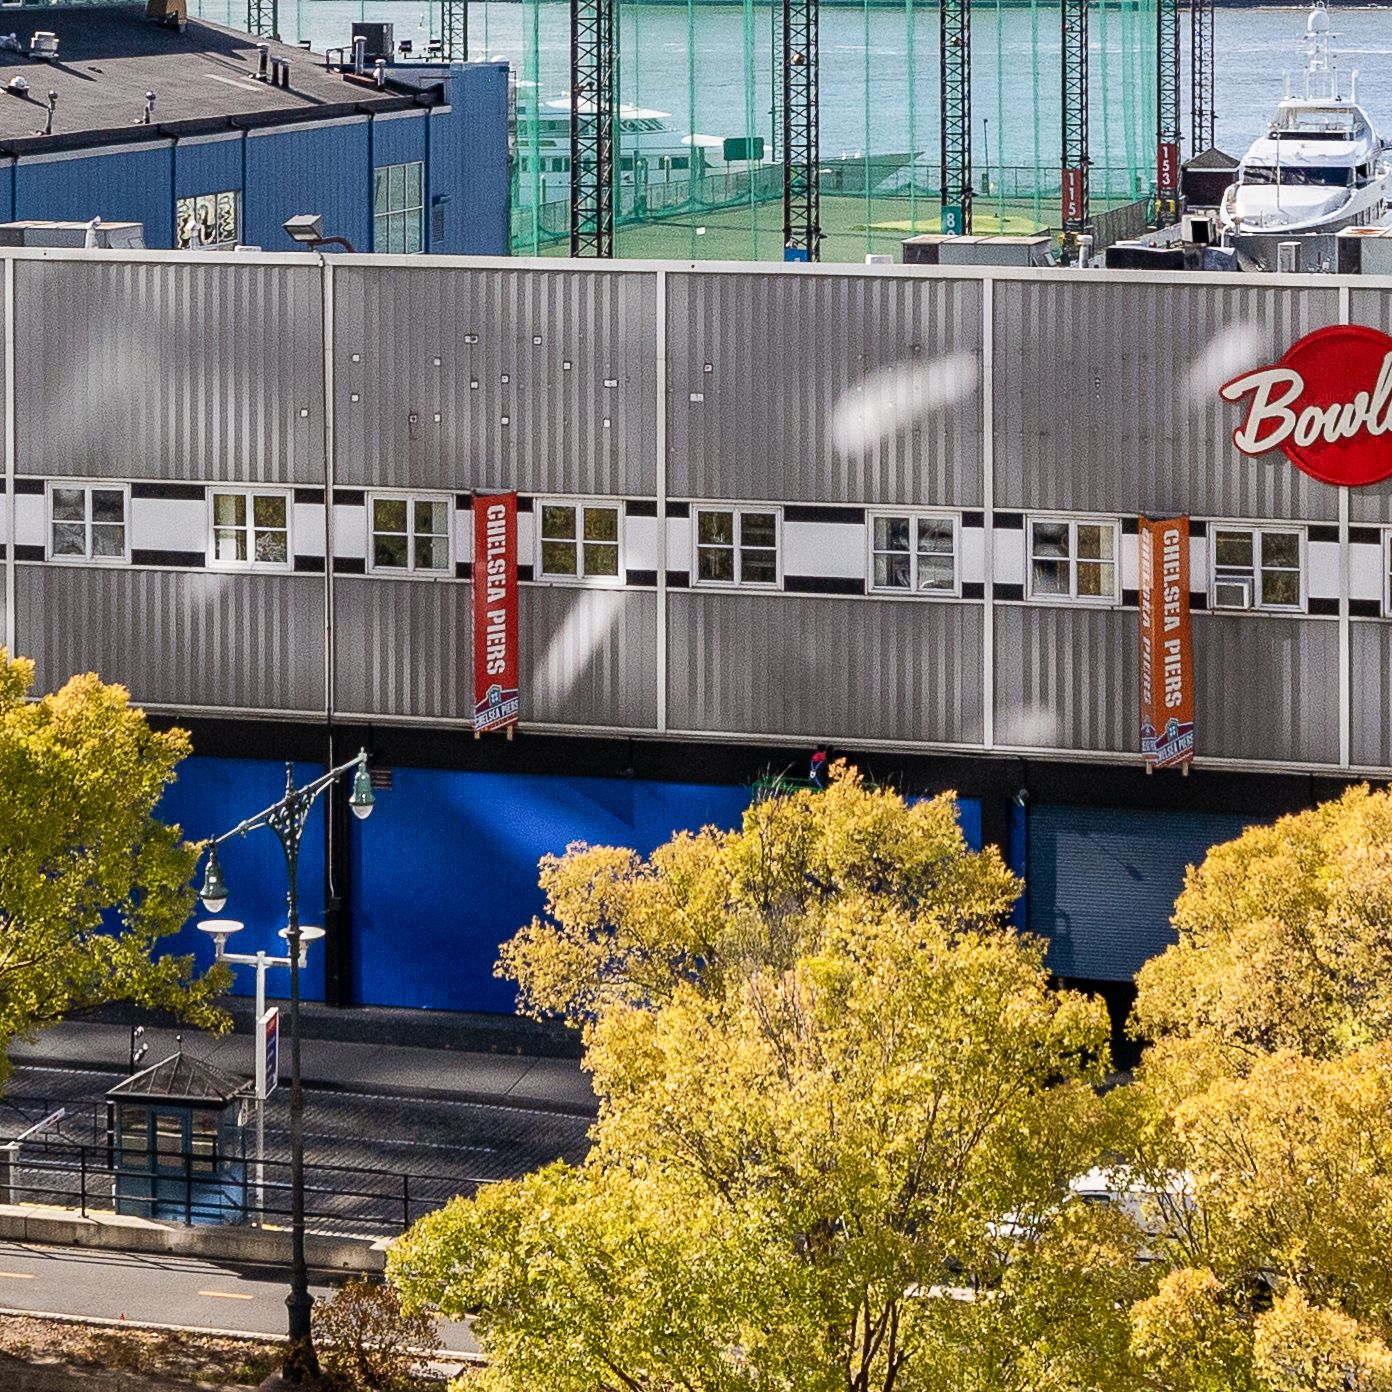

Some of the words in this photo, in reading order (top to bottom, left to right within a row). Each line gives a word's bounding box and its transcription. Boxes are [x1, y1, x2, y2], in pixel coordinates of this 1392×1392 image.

[1162, 146, 1170, 185] 153
[486, 504, 506, 604] CHELSEA
[1163, 529, 1181, 632] CHELSEA
[486, 608, 506, 675] PIERS
[1164, 638, 1182, 708] PIERS
